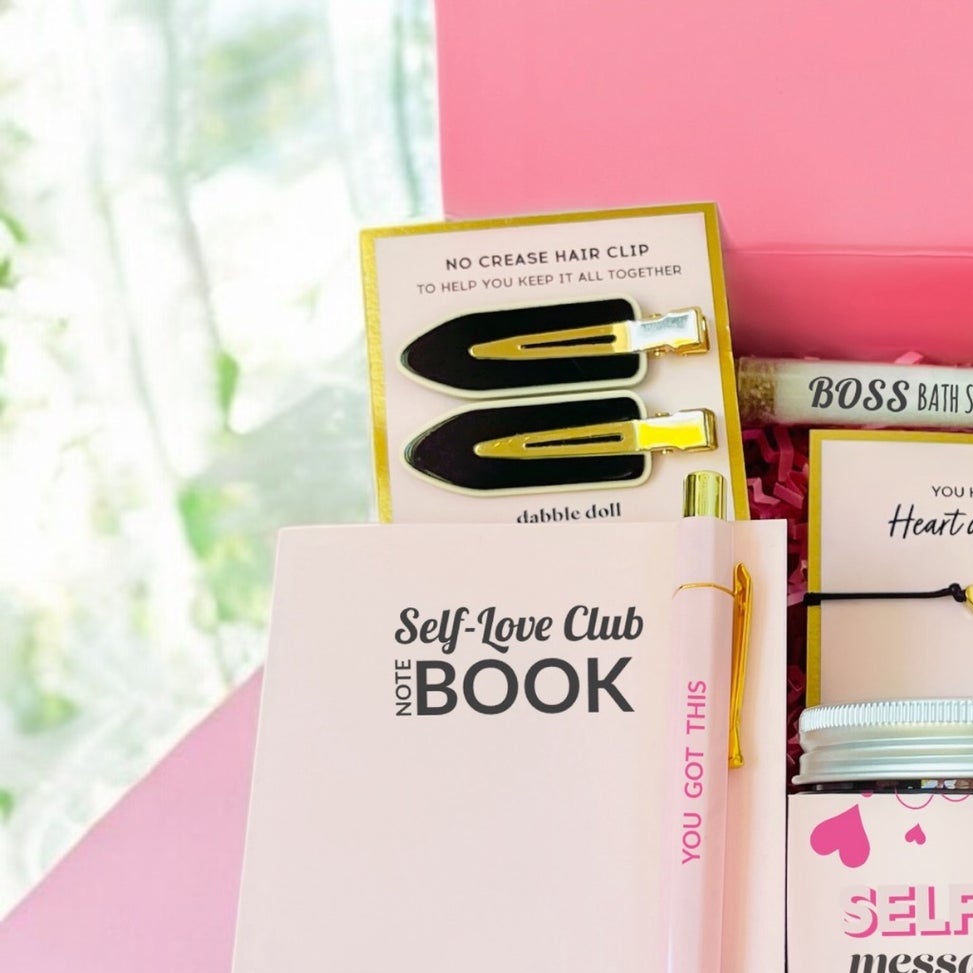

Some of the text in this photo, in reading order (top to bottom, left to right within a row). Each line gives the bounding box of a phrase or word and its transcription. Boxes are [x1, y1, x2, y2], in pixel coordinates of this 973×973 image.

[446, 244, 650, 271] NO CREASE HAIR CLIP
[417, 264, 682, 295] TO HELP YOU KEEP IT ALL TOGETHER
[808, 376, 910, 413] BOSS
[917, 382, 959, 414] BATH
[932, 485, 965, 499] YOU
[516, 502, 622, 524] dabble doll
[888, 503, 965, 540] Heart
[394, 604, 644, 654] Self-Love Club
[395, 656, 635, 716] NOTE BOOK
[681, 680, 707, 865] YOU GOT THIS
